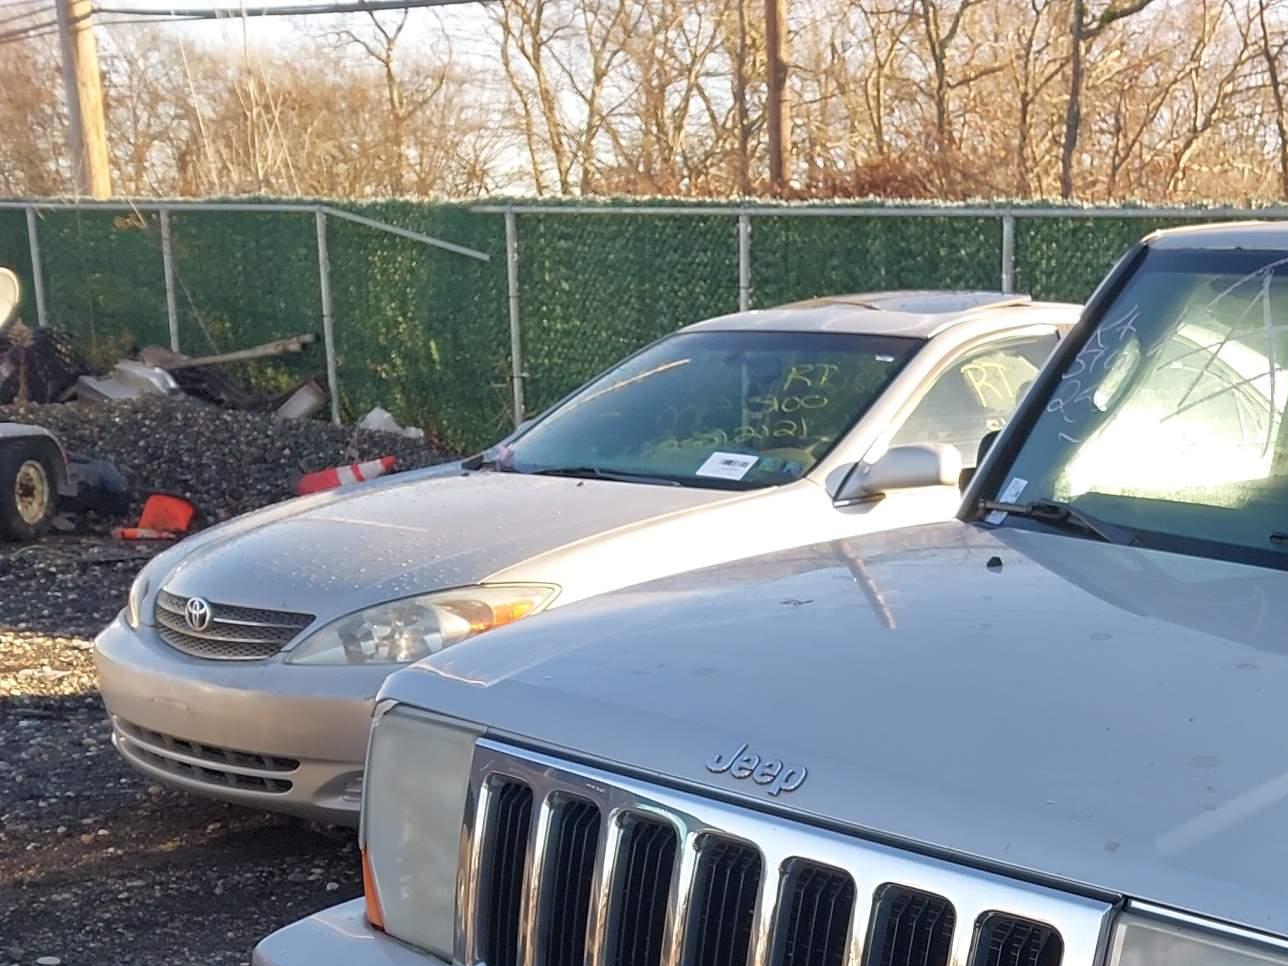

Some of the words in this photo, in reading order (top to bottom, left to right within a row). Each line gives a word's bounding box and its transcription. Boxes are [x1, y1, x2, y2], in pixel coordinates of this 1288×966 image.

[783, 362, 838, 390] RT
[960, 361, 1016, 407] RT
[704, 743, 809, 797] Jeep
